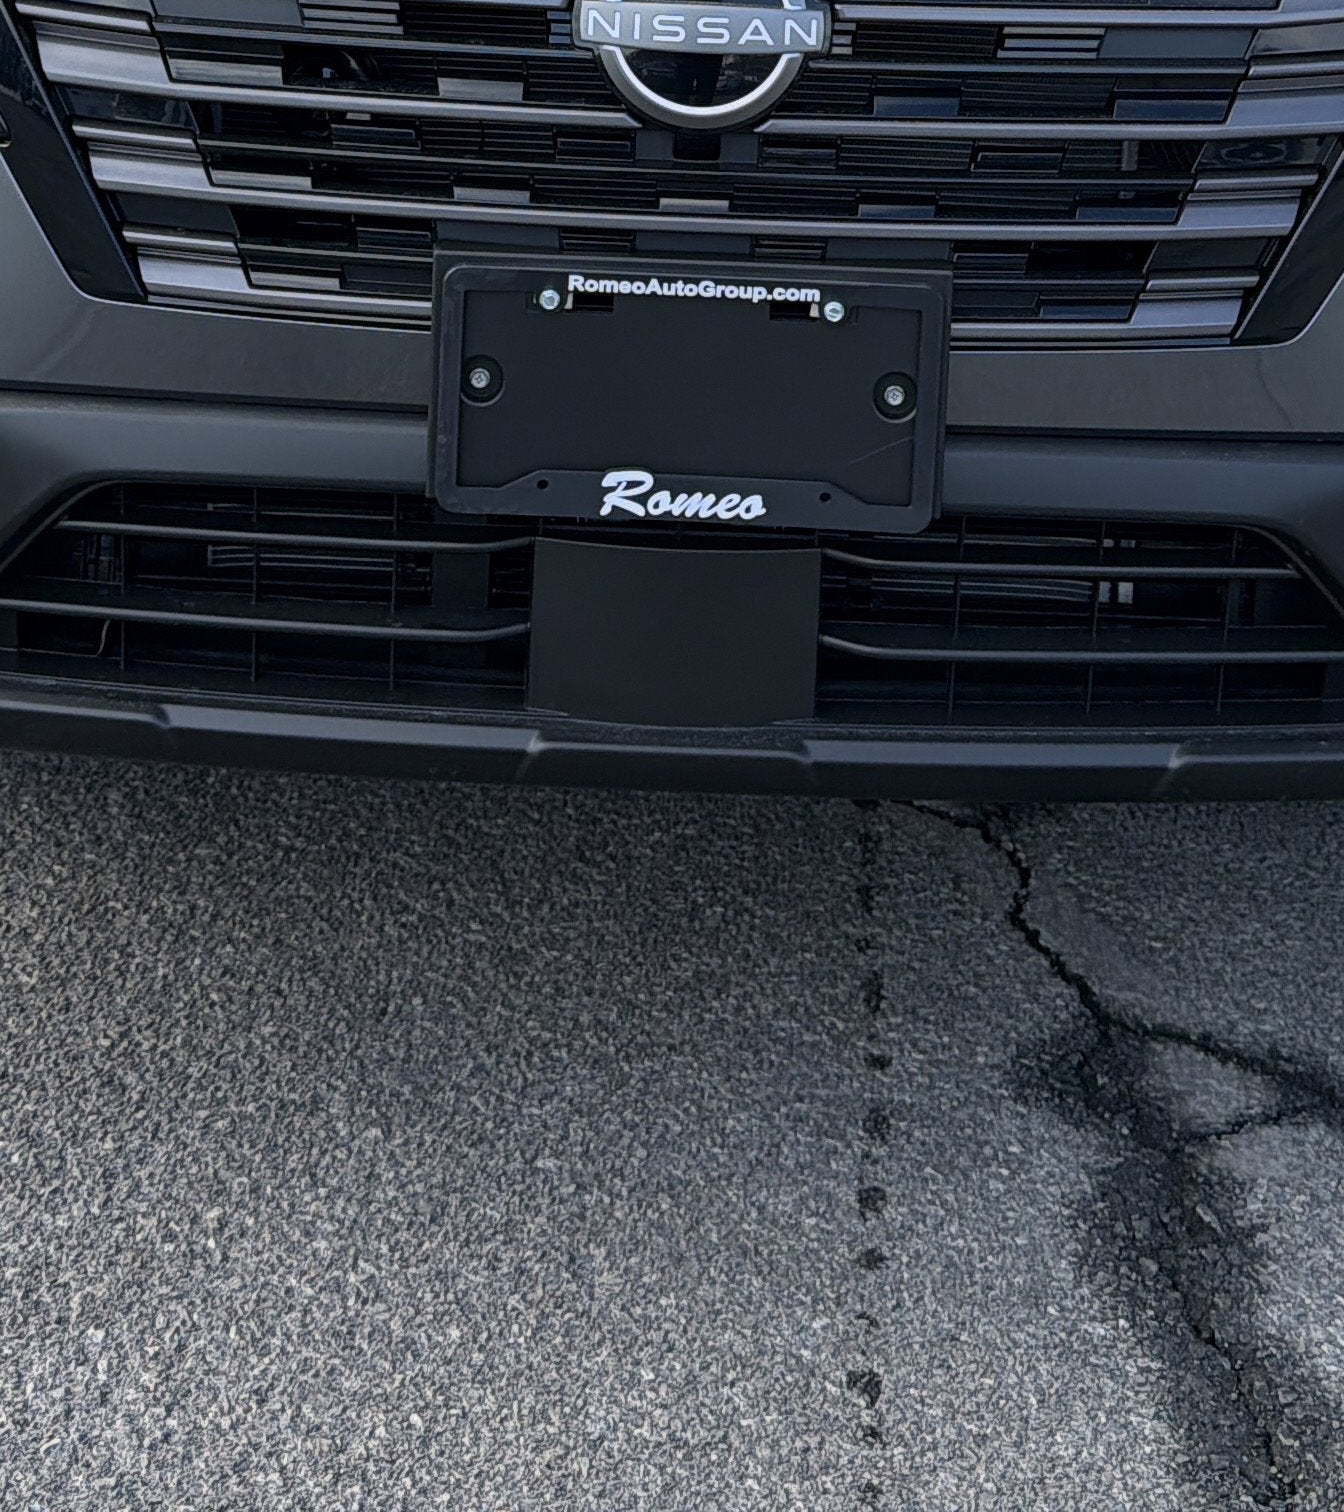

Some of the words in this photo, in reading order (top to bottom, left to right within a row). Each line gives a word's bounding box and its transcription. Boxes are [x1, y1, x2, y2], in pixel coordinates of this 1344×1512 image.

[587, 9, 818, 46] NISSAN
[567, 274, 821, 303] RomeoAutoGroup.com
[599, 470, 767, 520] Romeo
